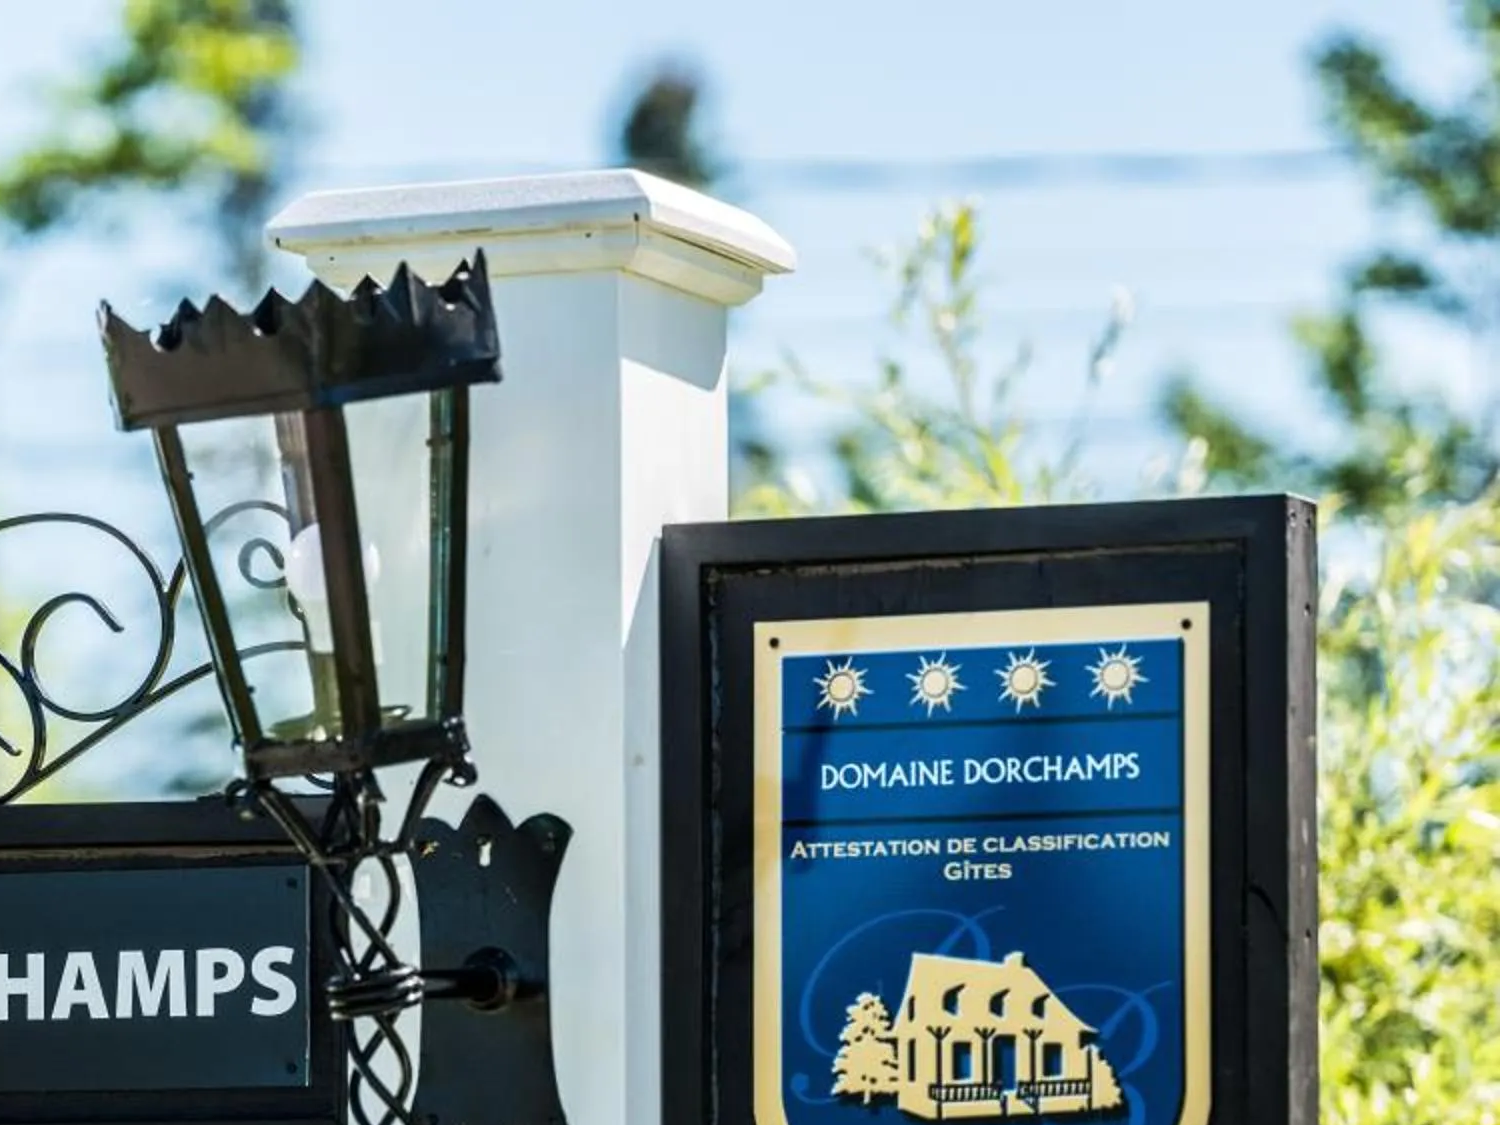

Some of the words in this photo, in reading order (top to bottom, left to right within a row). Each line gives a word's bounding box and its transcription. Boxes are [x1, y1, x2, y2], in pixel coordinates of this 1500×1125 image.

[820, 758, 955, 791] DOMAINE
[963, 752, 1141, 786] DORCHAMPS
[790, 838, 941, 860] ATTESTATION
[946, 836, 978, 855] DE
[982, 830, 1171, 853] CLASSIFICATION
